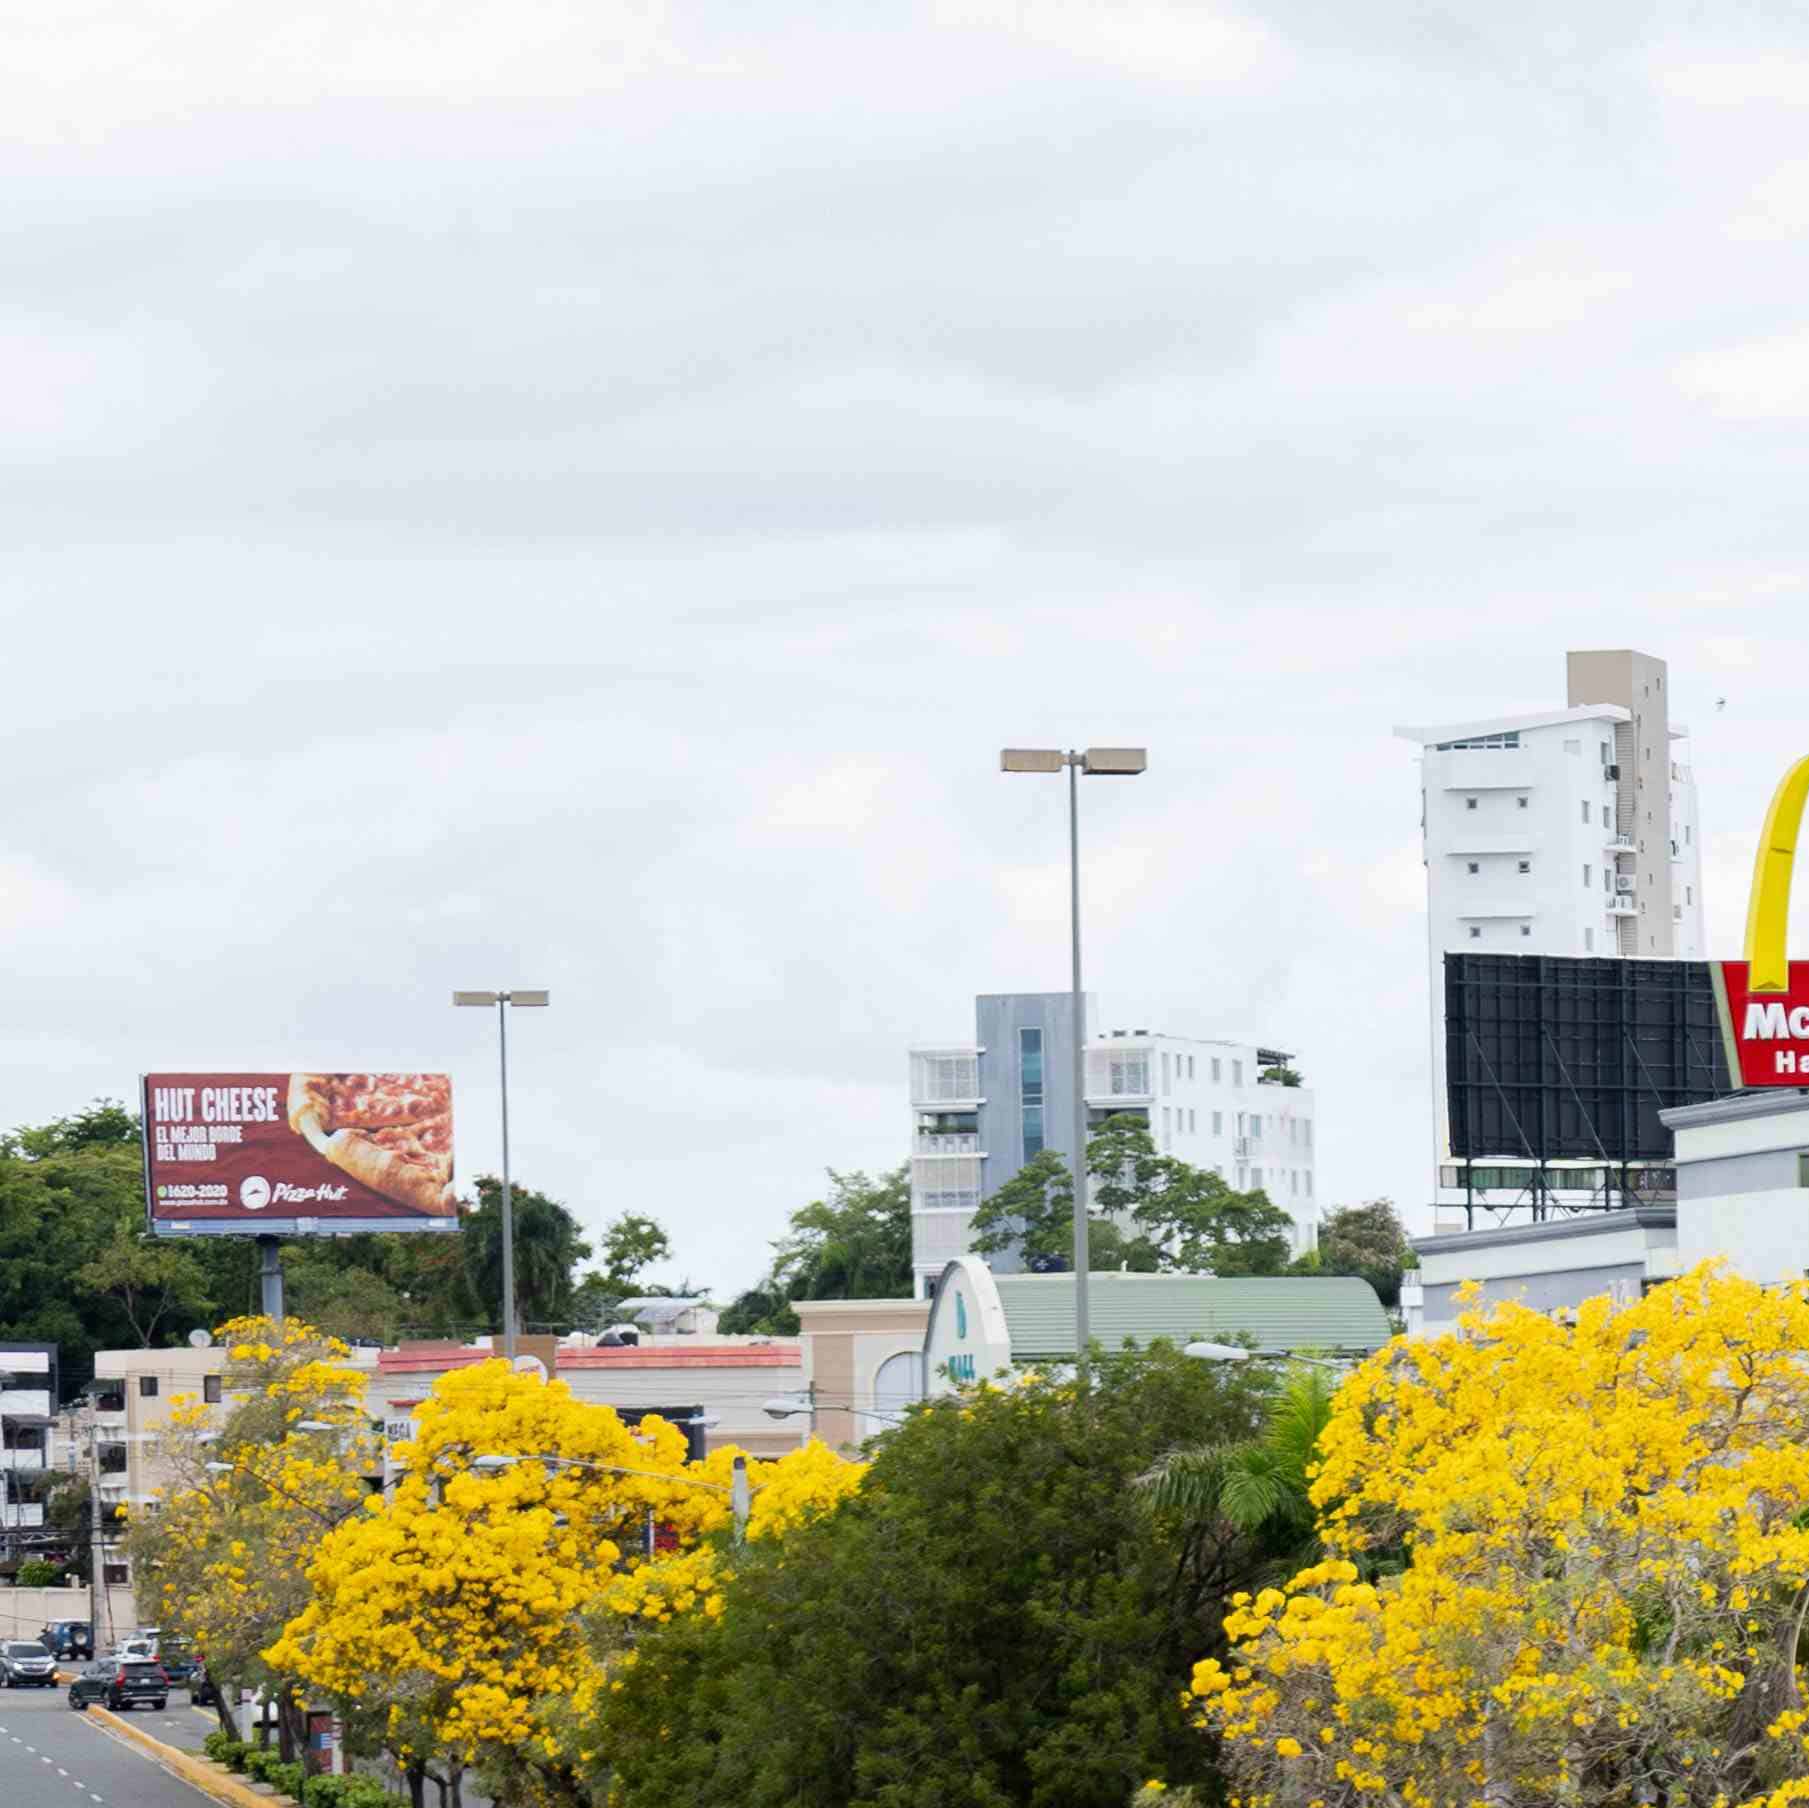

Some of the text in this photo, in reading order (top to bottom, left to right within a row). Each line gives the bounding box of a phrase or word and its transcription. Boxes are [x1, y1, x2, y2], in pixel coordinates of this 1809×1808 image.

[155, 1087, 279, 1121] HUT CHEESE
[156, 1126, 169, 1143] EL
[171, 1126, 207, 1143] MEJOR
[157, 1143, 217, 1161] DEL MUNDO
[272, 1183, 349, 1203] Pizza Hut
